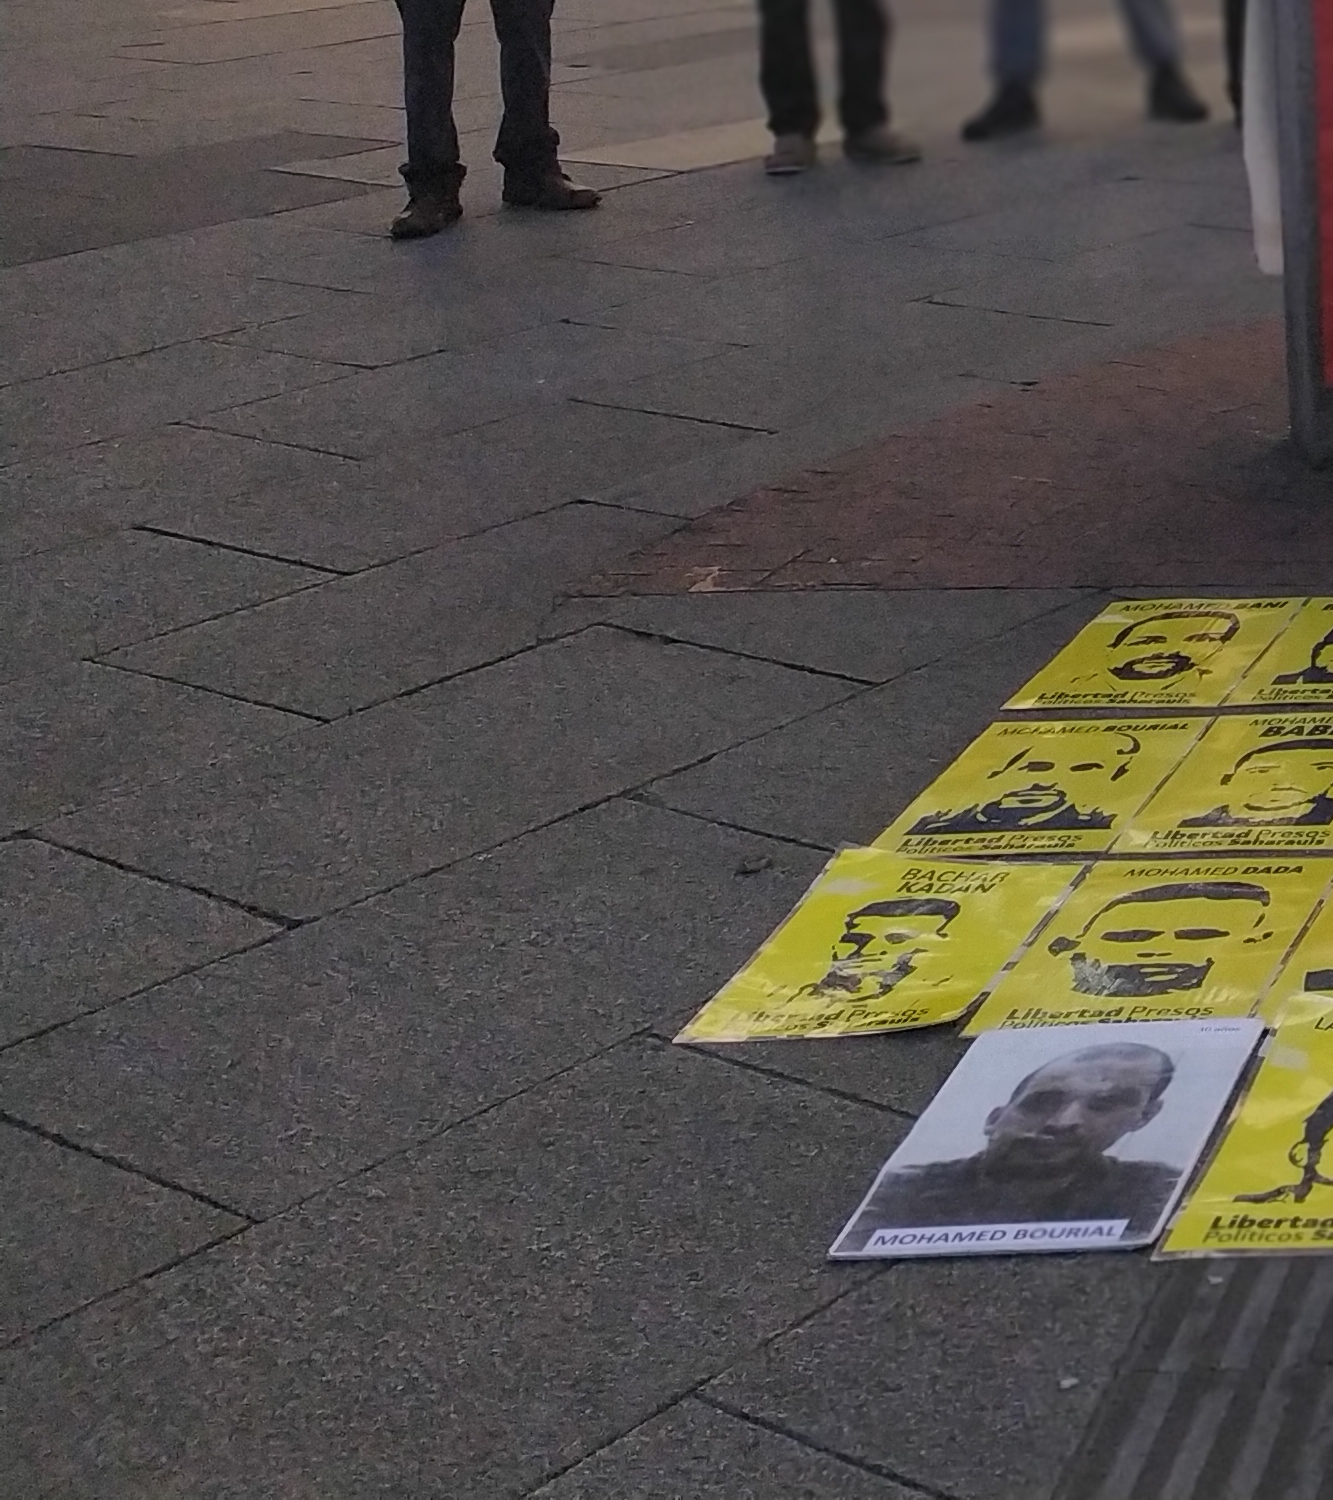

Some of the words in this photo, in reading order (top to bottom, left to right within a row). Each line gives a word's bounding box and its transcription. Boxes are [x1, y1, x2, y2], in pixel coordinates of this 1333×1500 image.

[997, 724, 1100, 736] MOHAMED
[1101, 722, 1189, 734] BOURIAL
[1124, 866, 1237, 877] MOHAMED
[1240, 865, 1305, 875] DADA
[873, 1229, 1007, 1247] MOHAMED
[1013, 1224, 1119, 1239] BOURIAL
